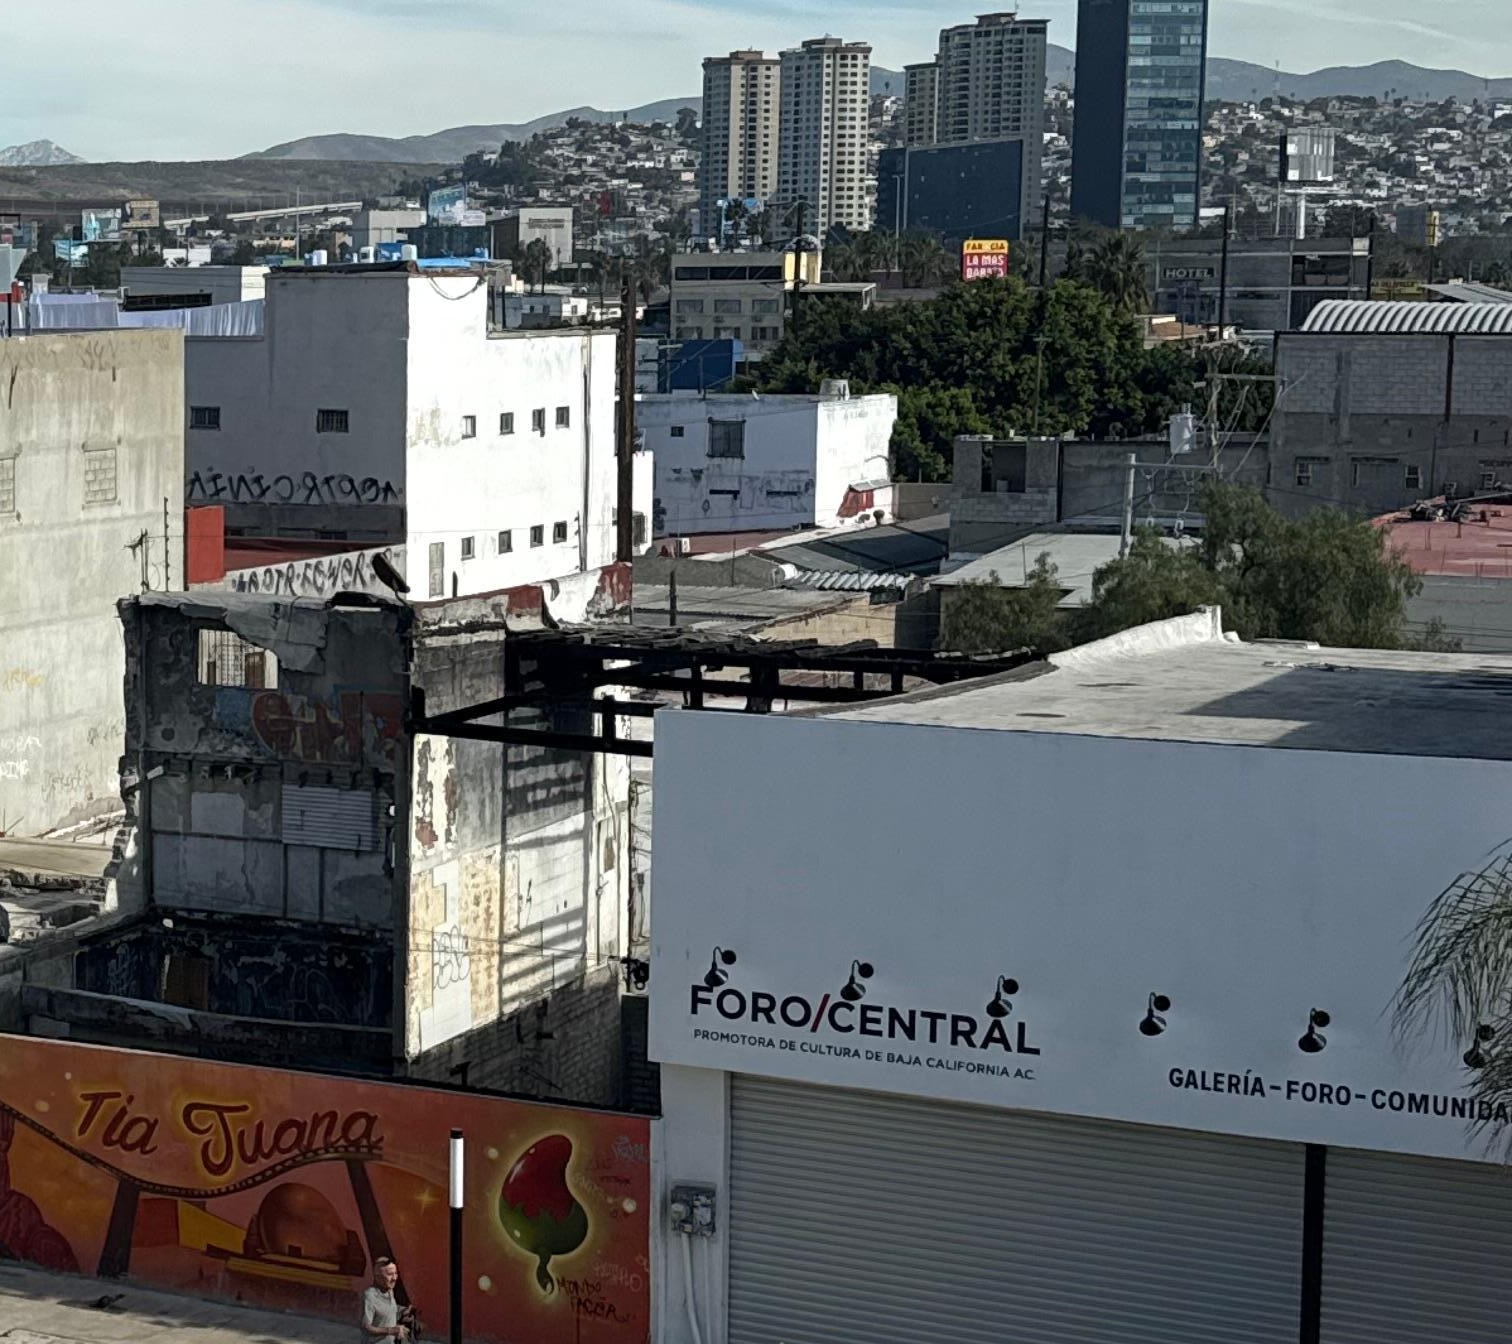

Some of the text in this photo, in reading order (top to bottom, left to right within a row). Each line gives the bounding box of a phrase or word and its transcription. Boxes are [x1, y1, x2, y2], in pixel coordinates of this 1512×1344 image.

[1165, 268, 1211, 279] HOTEL
[690, 984, 1040, 1056] FORO/CENTRAL
[694, 1028, 776, 1049] PROMOTORA
[779, 1038, 796, 1051] DE
[800, 1041, 861, 1060] CULTURA
[865, 1049, 883, 1062] DE
[886, 1052, 922, 1066] BAJA
[926, 1057, 1010, 1078] CALIFORNIA
[183, 1102, 384, 1177] Juana
